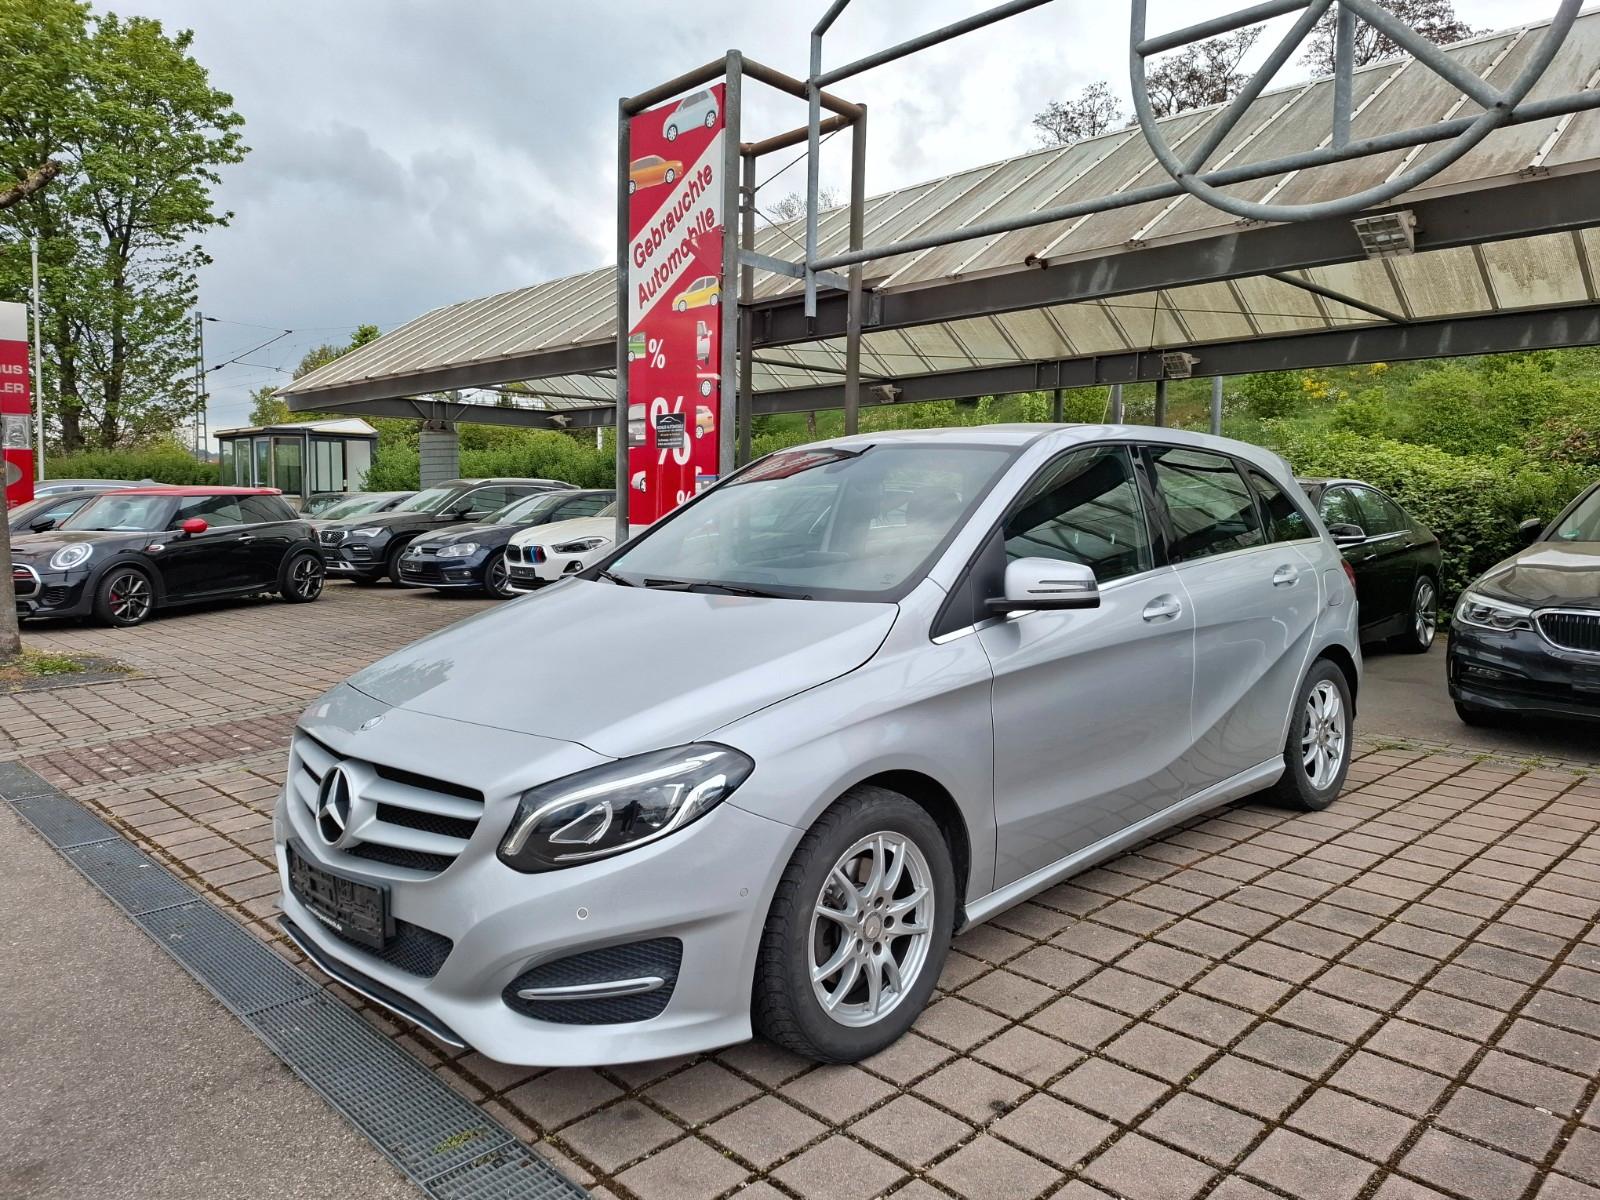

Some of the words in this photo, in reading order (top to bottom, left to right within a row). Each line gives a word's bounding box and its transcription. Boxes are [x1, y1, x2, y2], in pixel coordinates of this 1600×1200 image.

[633, 163, 713, 269] Gebrauchte
[638, 207, 715, 310] Automobile
[0, 364, 23, 375] US
[648, 338, 666, 369] %
